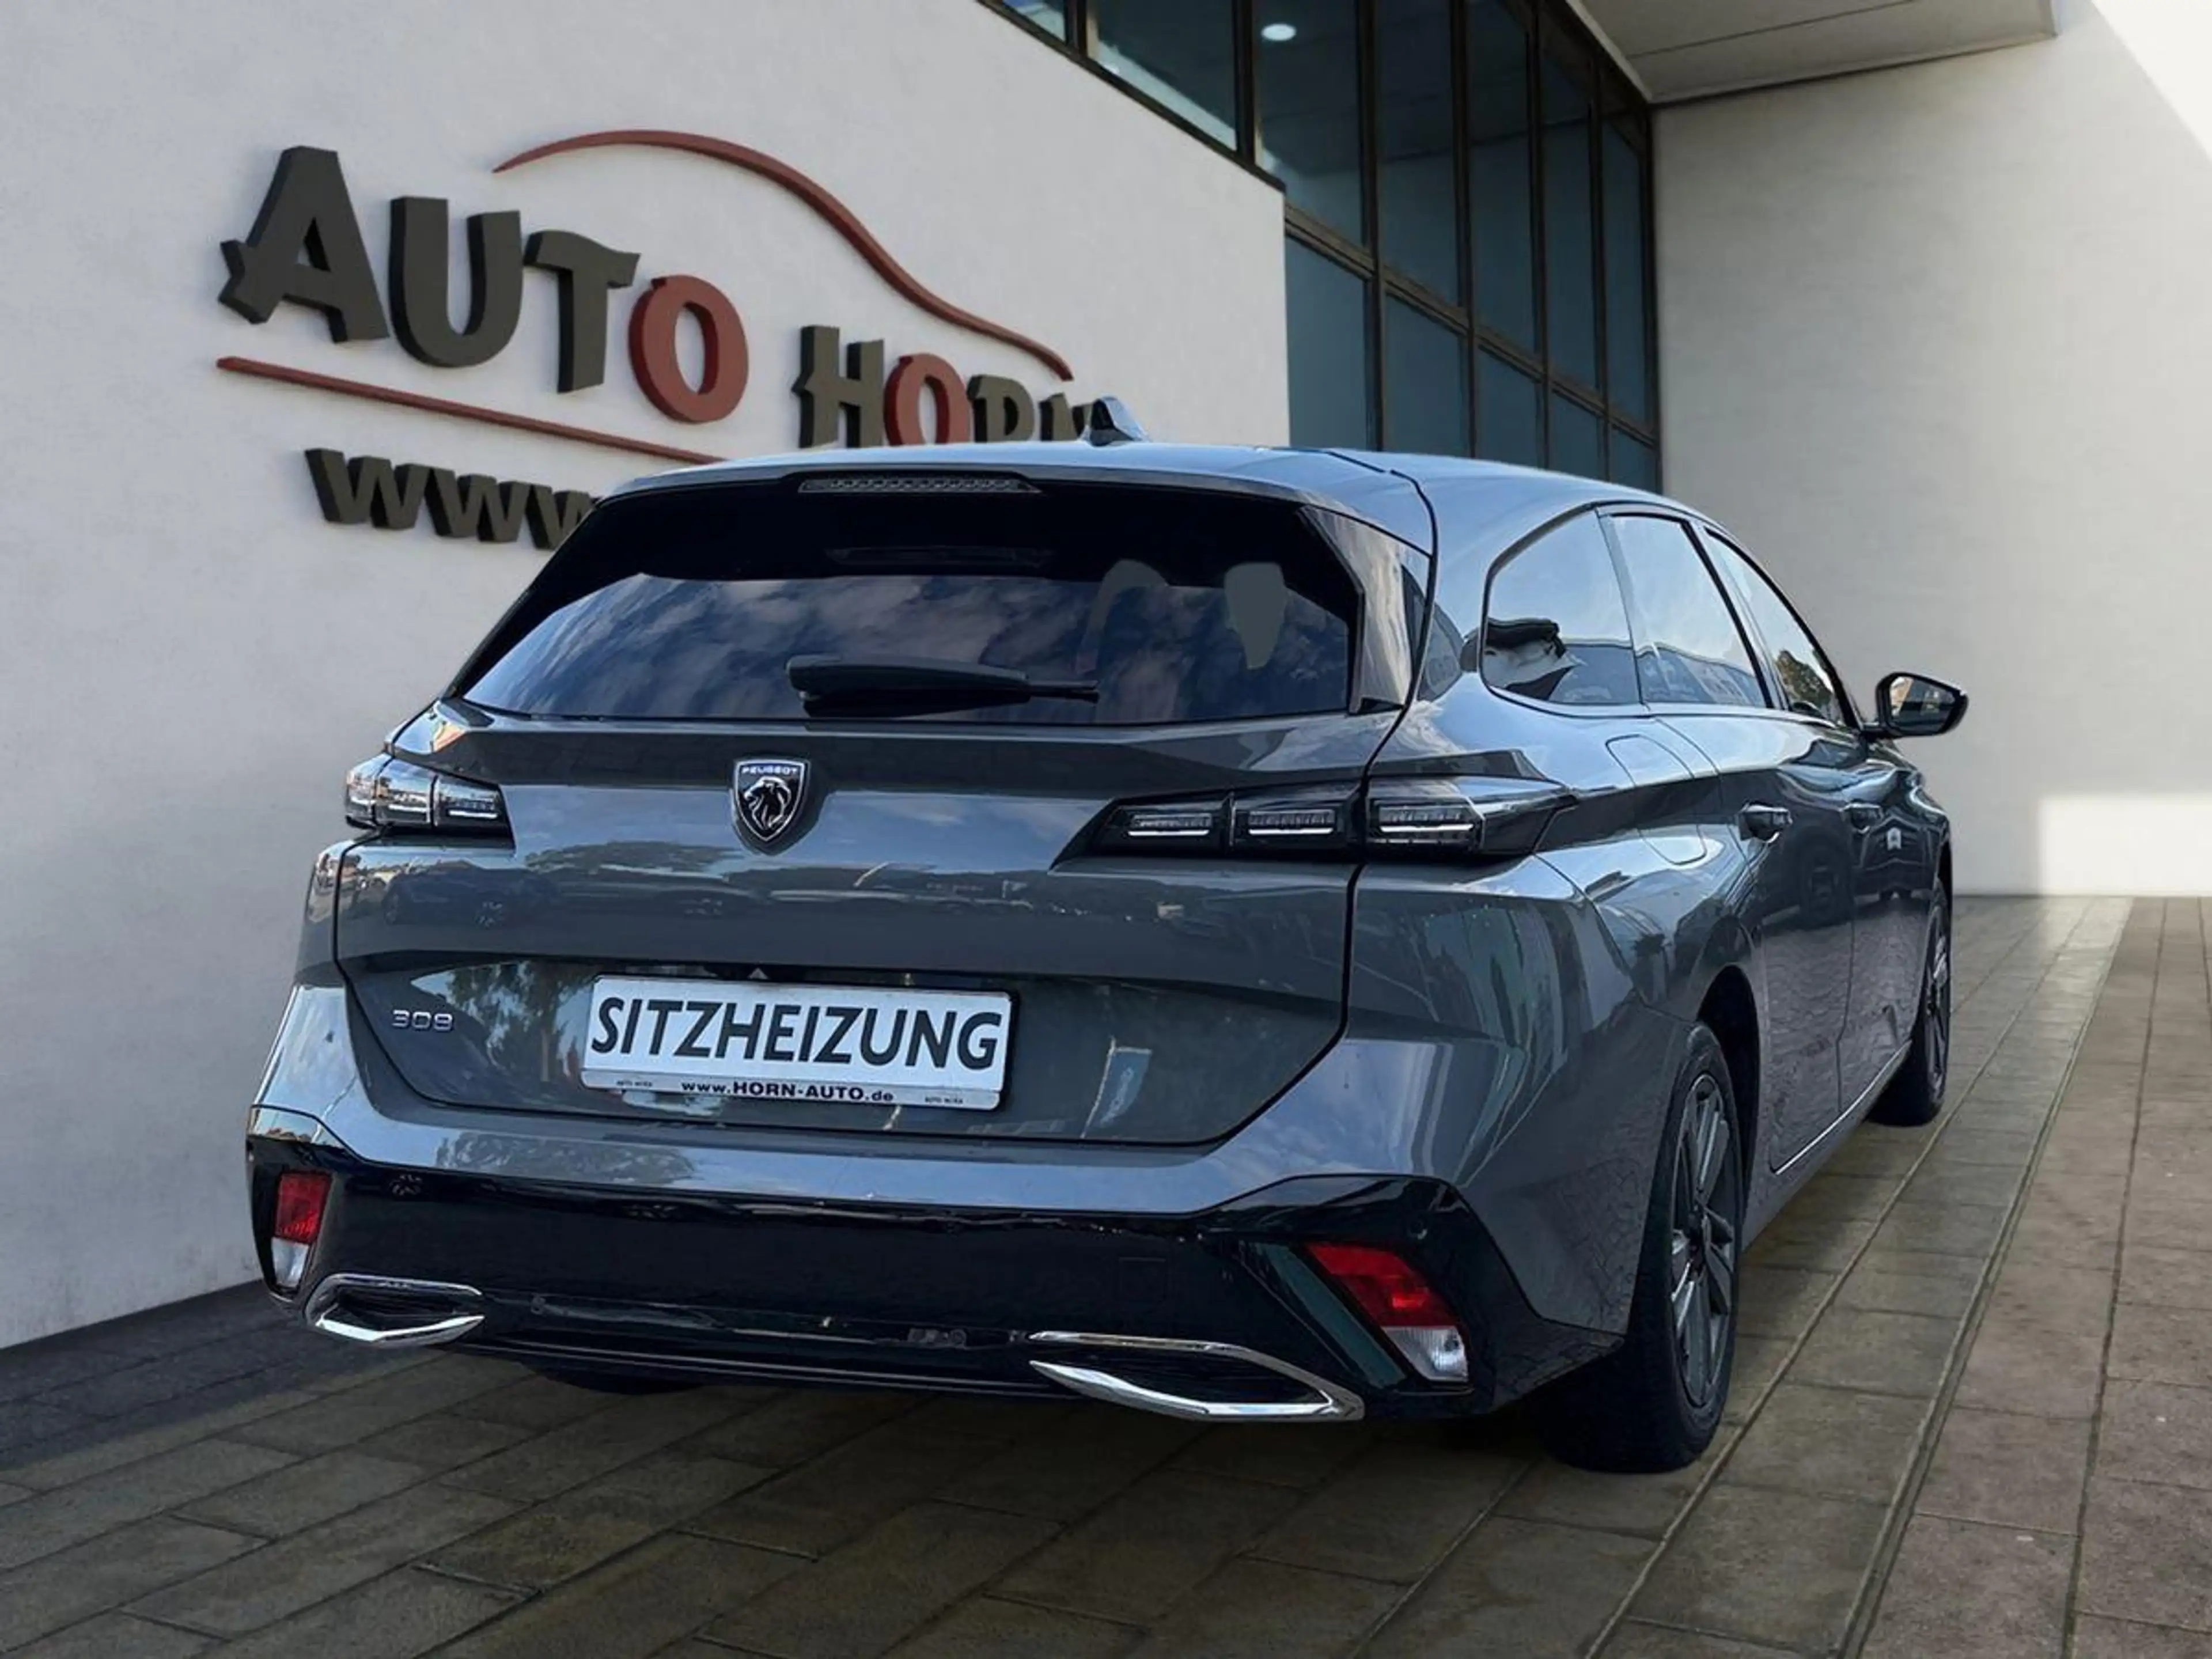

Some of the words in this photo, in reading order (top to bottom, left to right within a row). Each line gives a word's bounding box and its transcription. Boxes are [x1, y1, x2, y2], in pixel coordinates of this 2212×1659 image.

[218, 146, 749, 424] AUTO
[392, 1009, 453, 1031] 308
[591, 997, 1003, 1070] SITZHEIZUNG
[681, 1081, 894, 1102] www.HORN-AUTO.de
